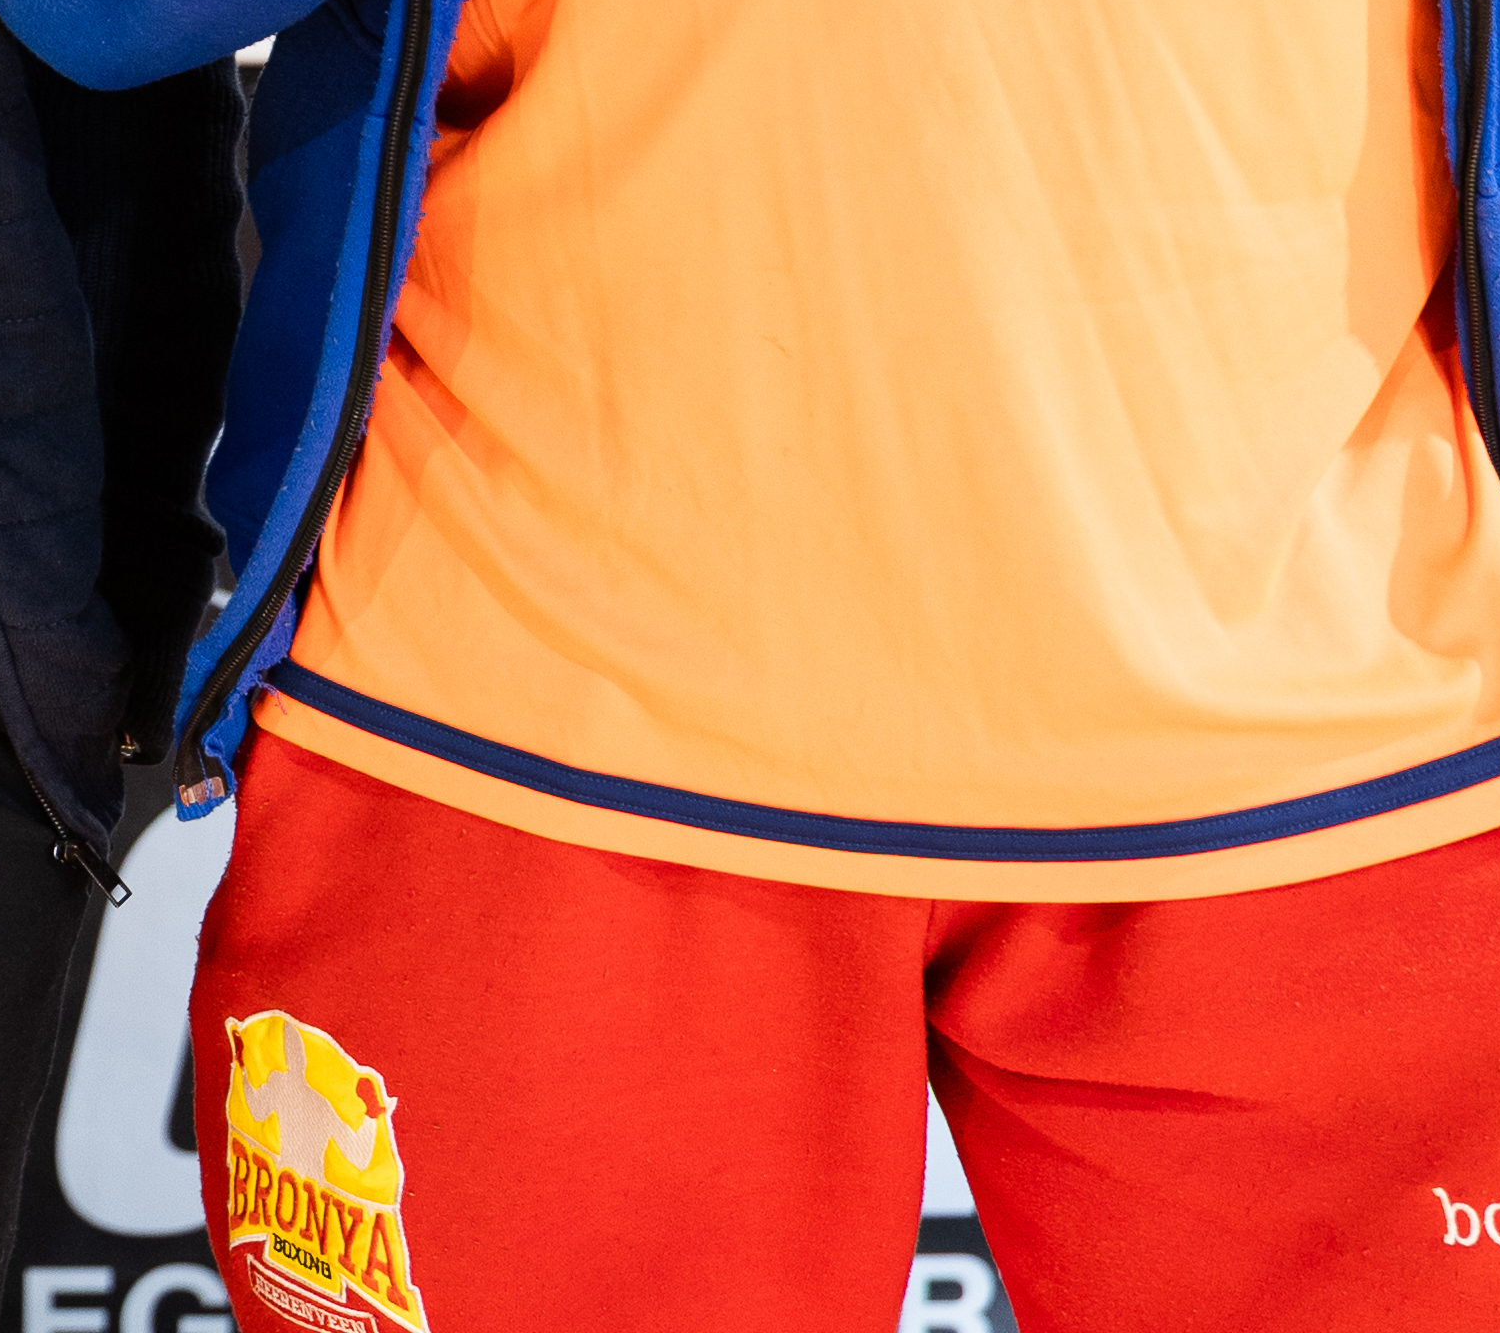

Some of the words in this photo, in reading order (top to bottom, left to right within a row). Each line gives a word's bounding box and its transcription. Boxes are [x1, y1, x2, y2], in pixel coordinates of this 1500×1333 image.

[230, 1137, 410, 1312] BRONYA
[272, 1232, 332, 1280] BOXING
[253, 1272, 368, 1333] HEERENVEEN
